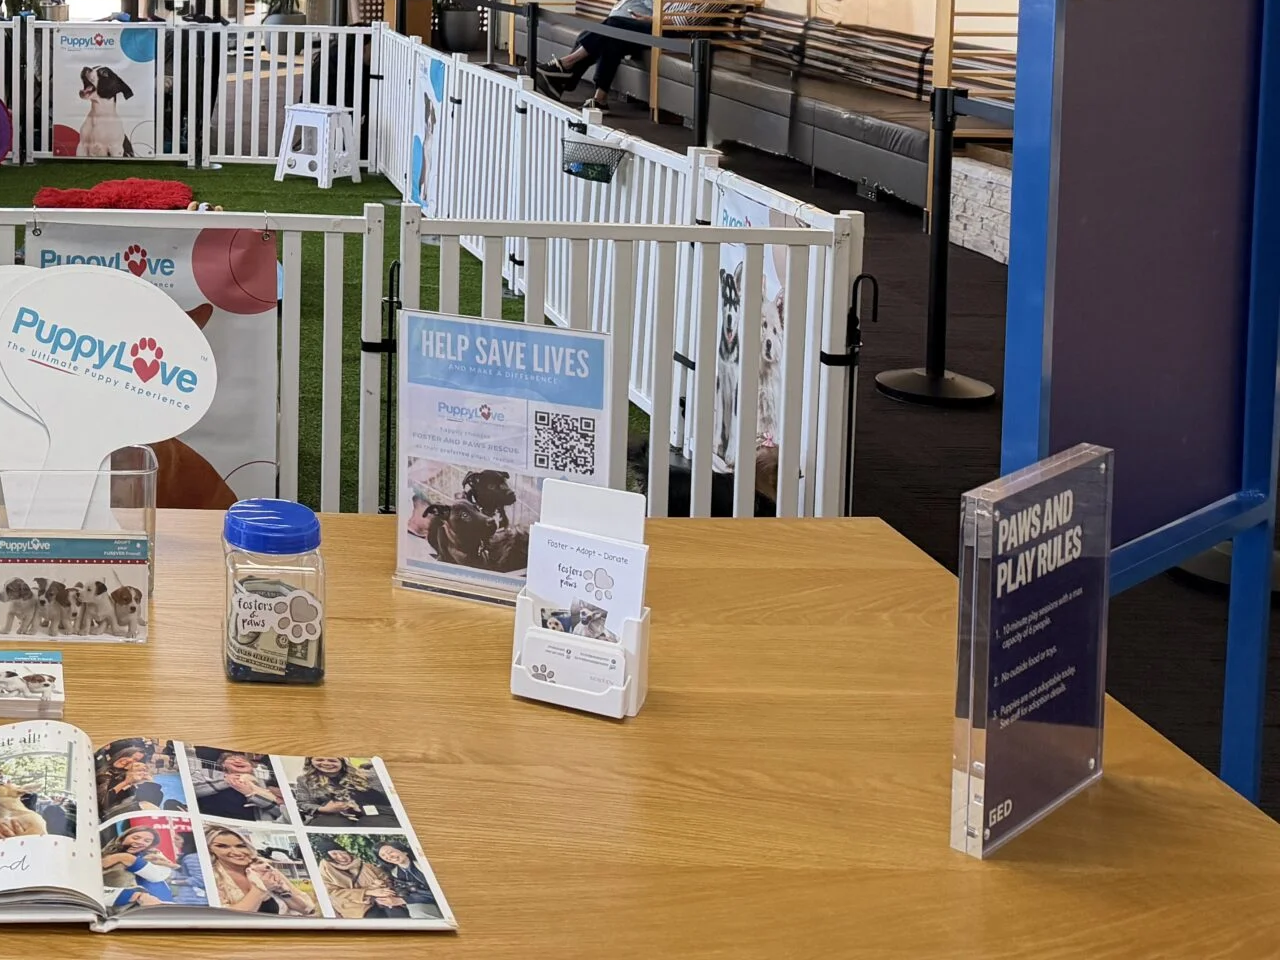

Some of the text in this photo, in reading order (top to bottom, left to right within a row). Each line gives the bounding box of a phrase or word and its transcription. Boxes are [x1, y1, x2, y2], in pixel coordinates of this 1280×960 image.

[422, 330, 590, 379] HELP SAVE LIVES
[7, 341, 191, 411] The Ultimate Puppy Experience
[448, 363, 466, 372] AND
[469, 367, 493, 376] MAKE
[505, 372, 557, 384] DIFFERENCE
[998, 489, 1073, 555] PAWS AND
[548, 540, 568, 550] Foster
[576, 547, 596, 558] Adopt
[603, 552, 629, 564] Donate
[996, 524, 1082, 599] PLAY RULES
[242, 619, 265, 629] paws
[19, 733, 41, 744] all!
[989, 799, 1012, 828] GED
